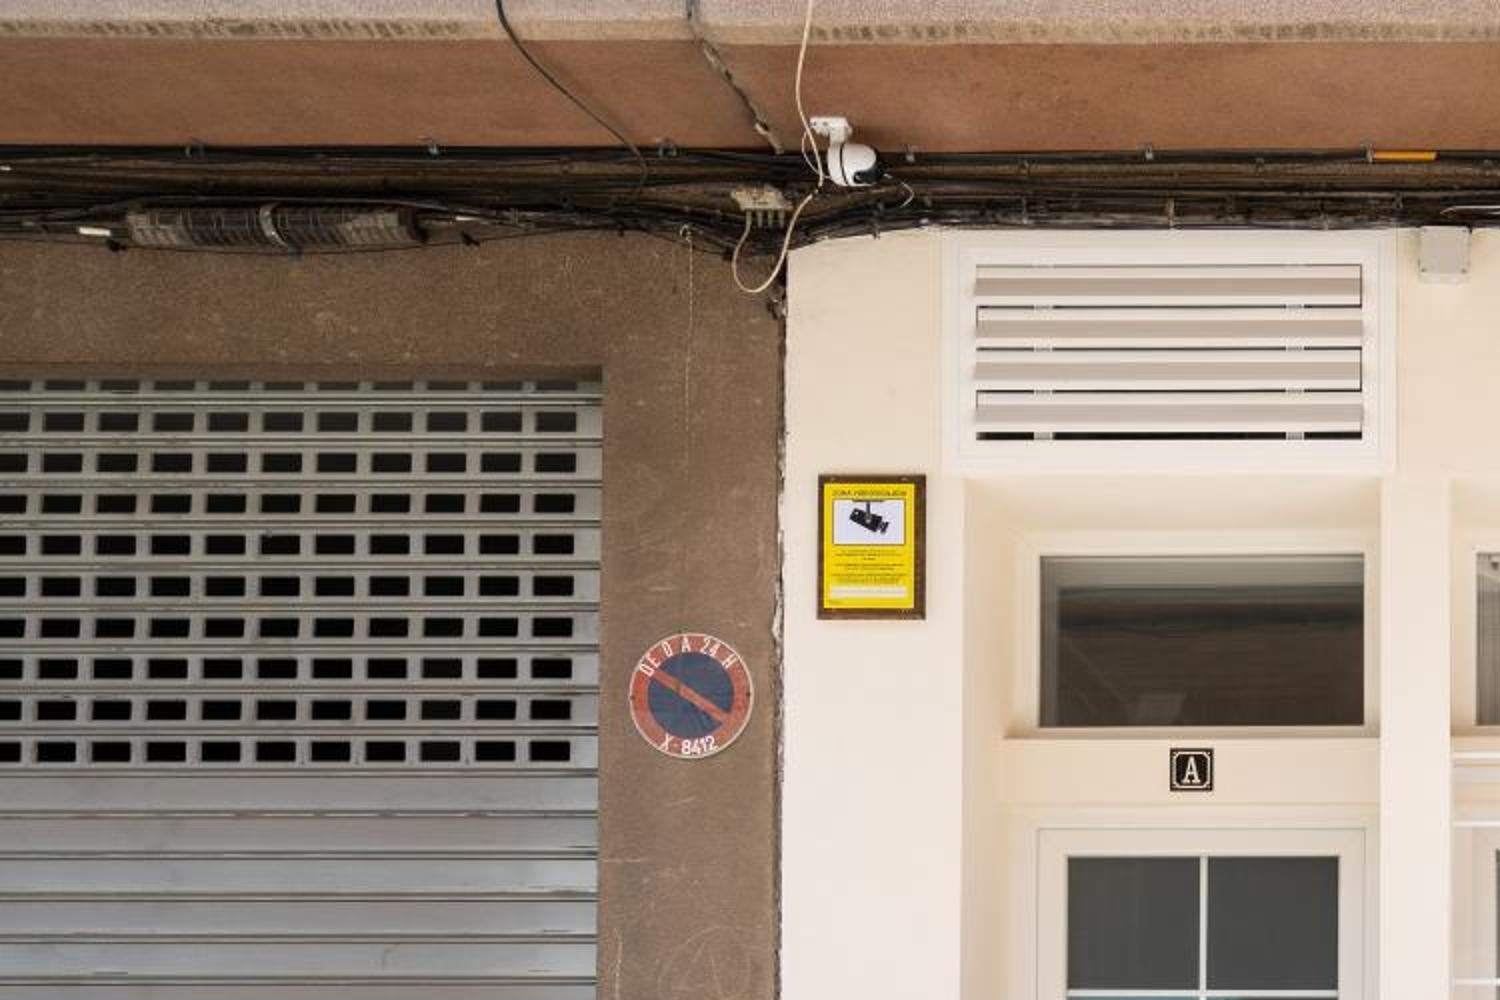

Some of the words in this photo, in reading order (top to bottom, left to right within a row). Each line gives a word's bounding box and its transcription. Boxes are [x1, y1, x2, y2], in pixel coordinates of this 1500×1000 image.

[640, 652, 661, 677] DE
[681, 635, 692, 653] A
[700, 637, 721, 657] 24
[721, 653, 738, 669] H
[1181, 756, 1201, 784] A
